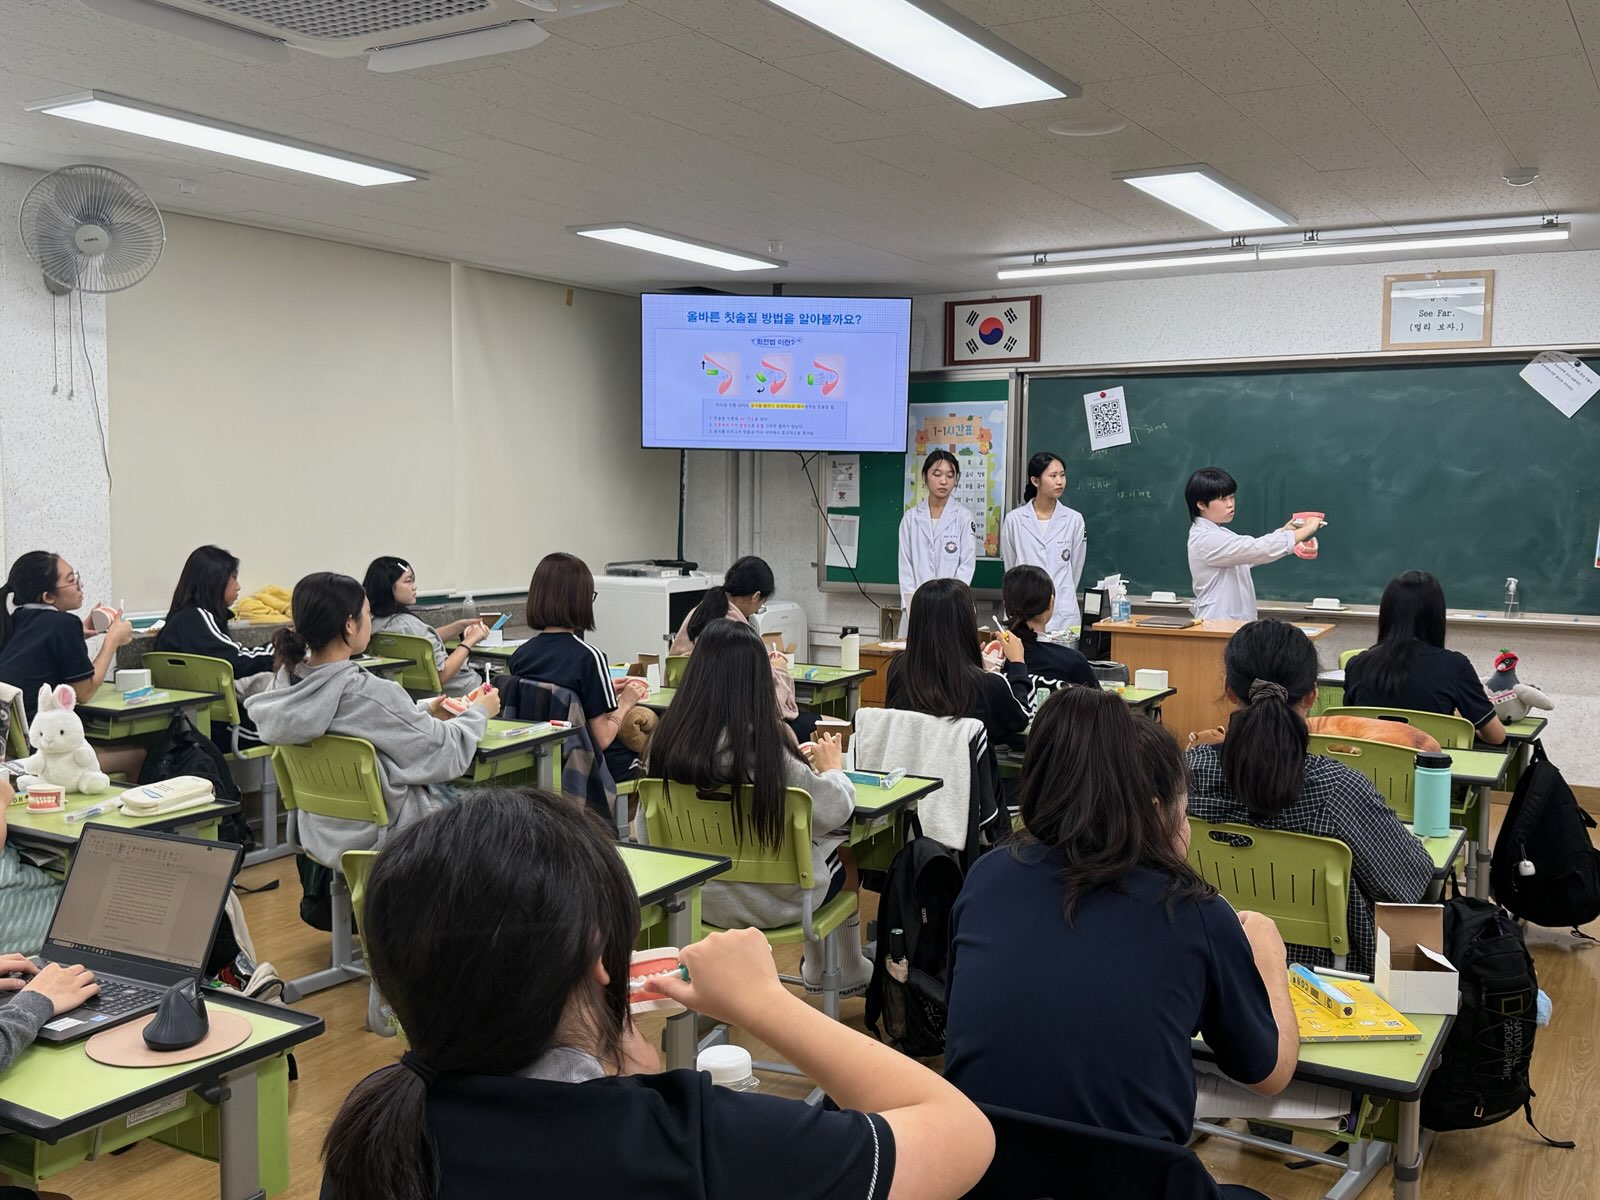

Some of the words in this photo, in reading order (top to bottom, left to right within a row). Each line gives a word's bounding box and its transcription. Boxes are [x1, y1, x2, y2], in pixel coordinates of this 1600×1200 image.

[687, 311, 721, 323] 올바른
[724, 311, 758, 324] 칫솔질
[761, 312, 795, 325] 방법을
[799, 313, 862, 326] 알아볼까요?
[1418, 309, 1434, 318] See
[1437, 309, 1456, 318] Far.
[1409, 323, 1431, 332] (멀리
[1437, 322, 1464, 332] 보자.)
[1513, 1019, 1522, 1067] NATIONAL
